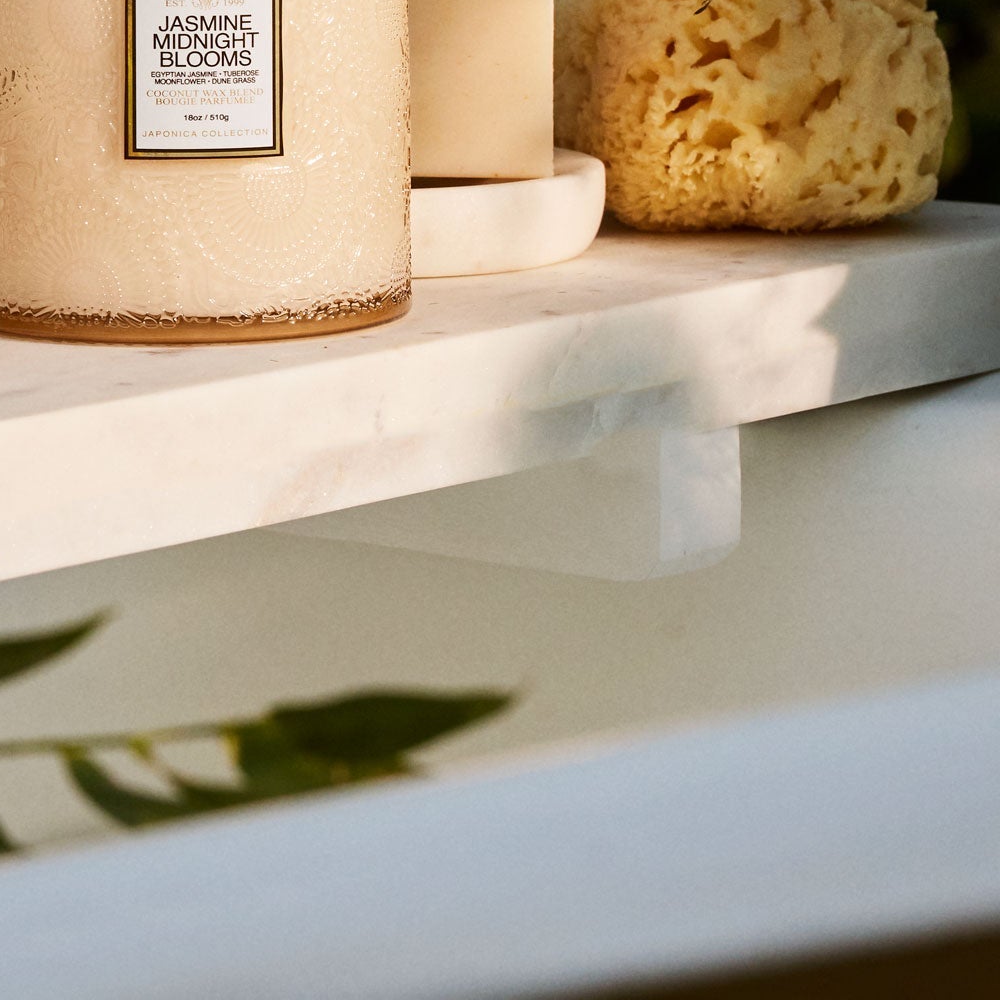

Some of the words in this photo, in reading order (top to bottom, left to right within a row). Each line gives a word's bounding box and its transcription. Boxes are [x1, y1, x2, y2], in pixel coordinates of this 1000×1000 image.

[158, 14, 252, 32] JASMINE
[152, 32, 260, 50] MIDNIGHT
[159, 49, 252, 68] BLOOMS
[146, 89, 199, 98] COCONUT
[202, 89, 226, 97] WAX
[229, 88, 264, 97] BLEND
[155, 97, 197, 105] BOUGIE
[209, 114, 229, 122] 510g
[142, 129, 197, 138] JAPONICA
[201, 128, 269, 137] COLLECTION
